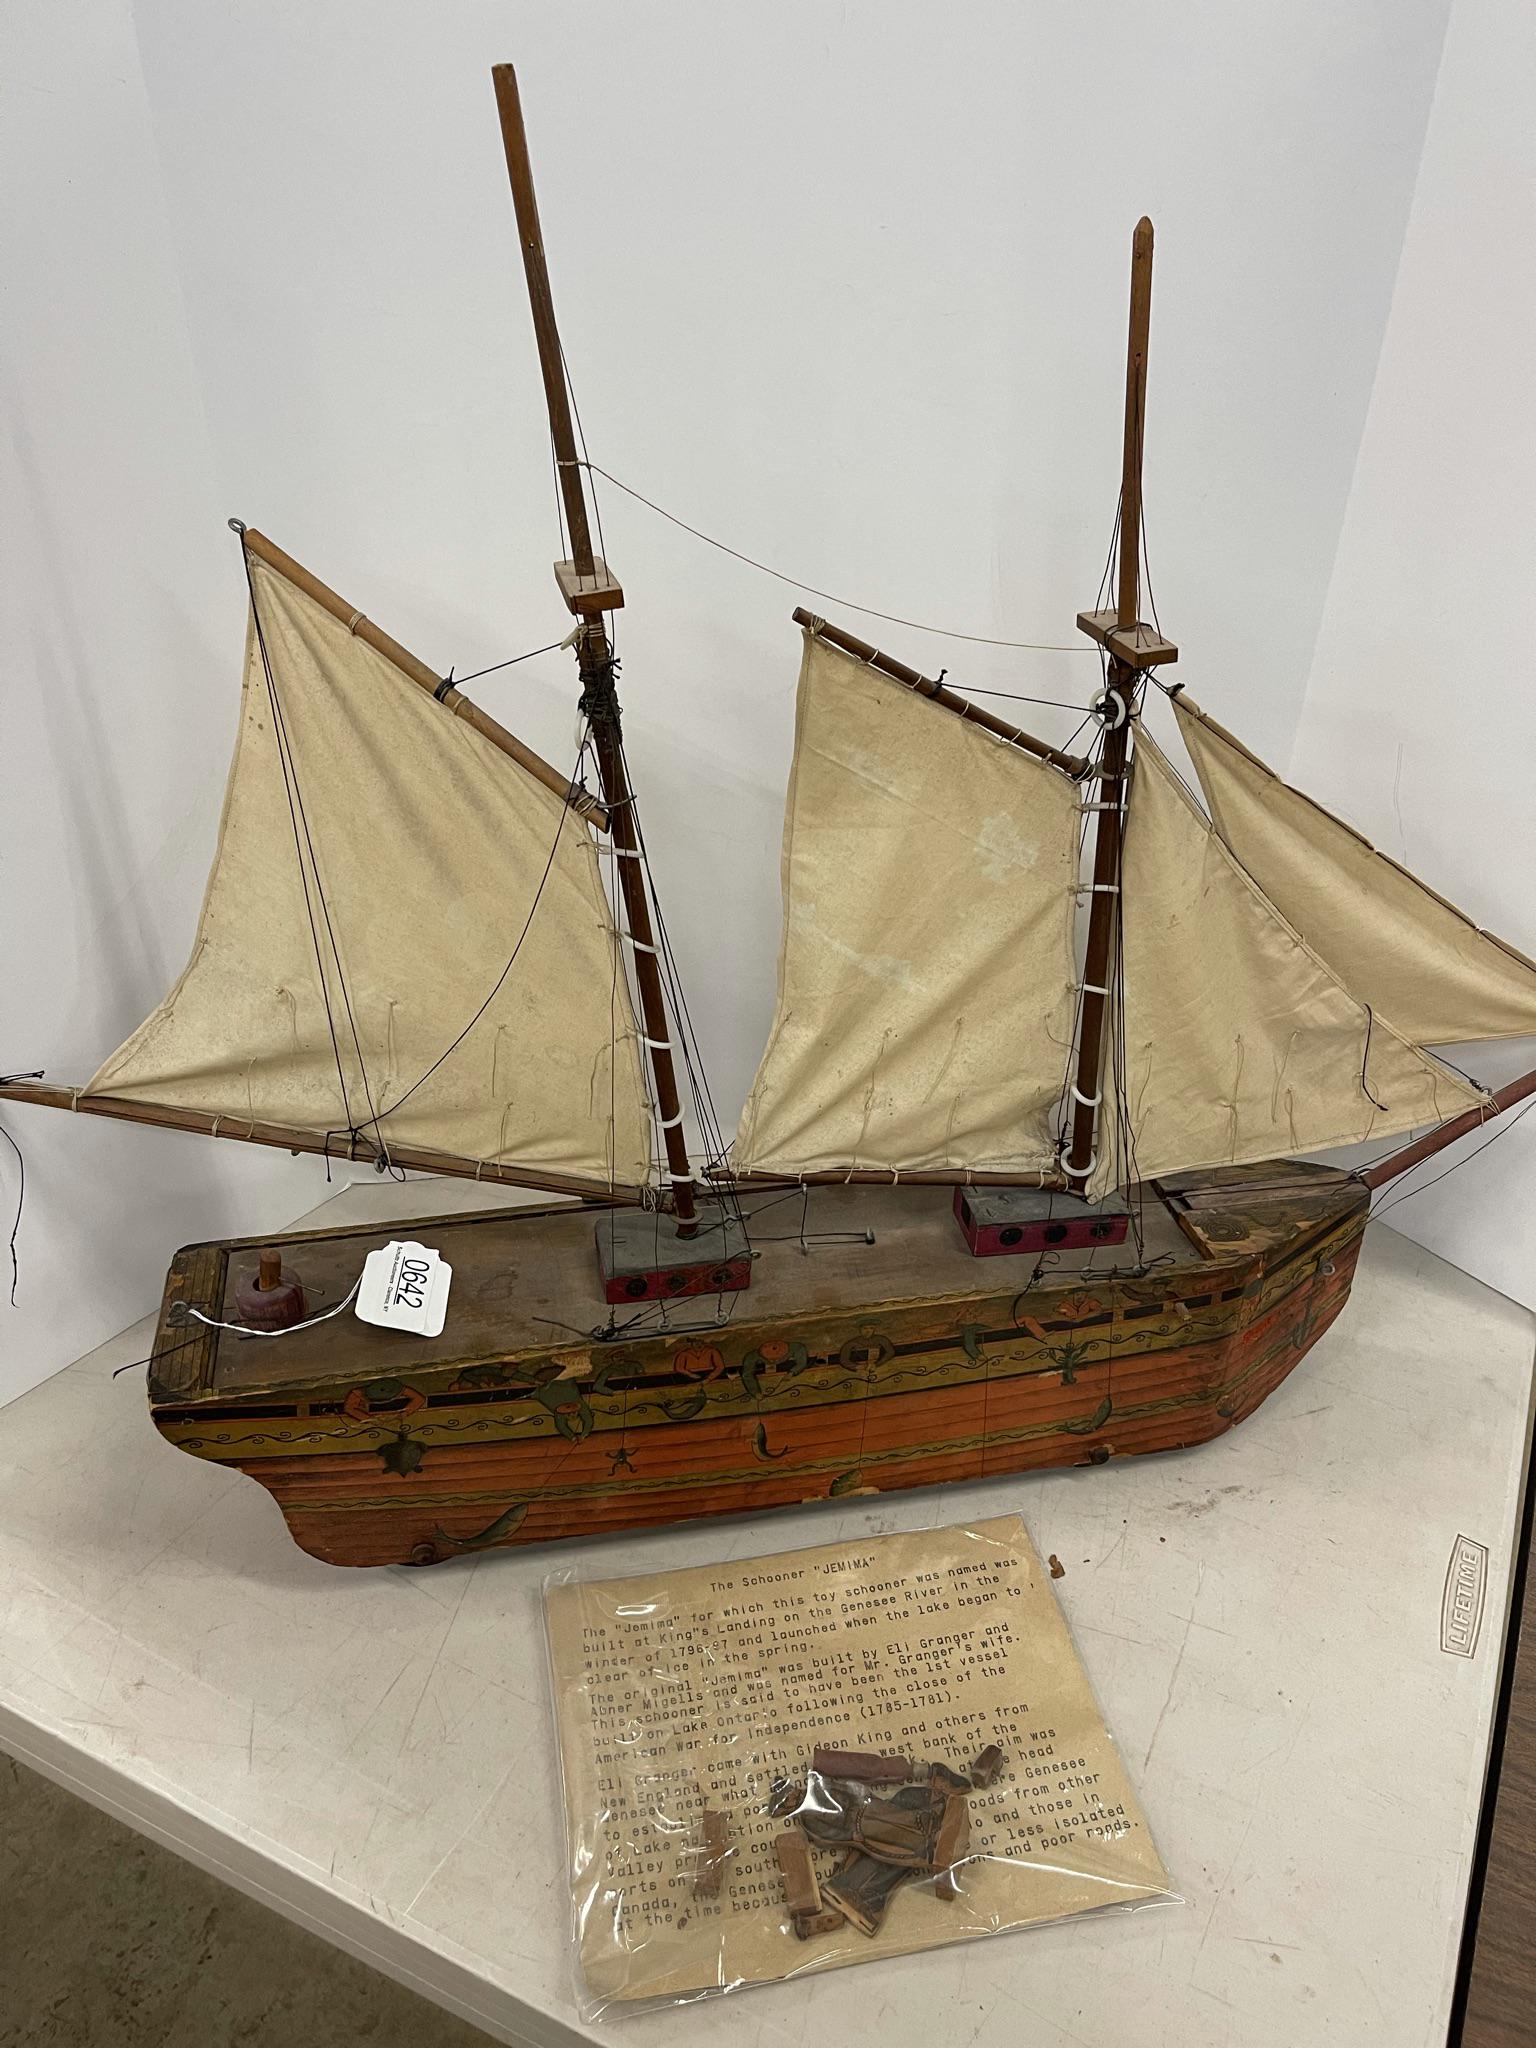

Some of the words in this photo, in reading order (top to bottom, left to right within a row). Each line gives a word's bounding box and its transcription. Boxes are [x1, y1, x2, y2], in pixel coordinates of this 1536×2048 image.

[396, 1259, 430, 1308] 0642
[710, 1582, 733, 1593] The
[742, 1568, 805, 1587] Schooner
[814, 1556, 876, 1574] "JEMIMA"
[583, 1628, 606, 1638] The
[691, 1612, 713, 1622] for
[723, 1602, 764, 1617] which
[773, 1597, 805, 1609] this
[813, 1592, 836, 1603] toy
[845, 1577, 907, 1597] schooner
[916, 1571, 940, 1583] was
[948, 1562, 987, 1577] named
[994, 1558, 1018, 1569] was
[583, 1639, 625, 1653] built
[635, 1636, 650, 1647] at
[717, 1616, 776, 1634] Landing
[784, 1613, 800, 1622] on
[809, 1607, 832, 1618] the
[840, 1596, 897, 1614] Genesee
[904, 1586, 943, 1602] River
[954, 1582, 968, 1592] in
[977, 1575, 1000, 1586] the
[1449, 1551, 1478, 1645] LIFETIME
[645, 1651, 661, 1662] of
[738, 1634, 762, 1647] and
[772, 1622, 837, 1641] launched
[845, 1616, 877, 1629] when
[886, 1610, 910, 1621] the
[918, 1602, 950, 1616] lake
[958, 1592, 998, 1607] began
[1006, 1587, 1021, 1597] to
[587, 1671, 630, 1685] clear
[639, 1667, 654, 1678] of
[666, 1661, 689, 1673] ice
[701, 1658, 715, 1668] in
[724, 1651, 749, 1663] the
[758, 1642, 814, 1659] spring.
[589, 1693, 614, 1705] The
[624, 1680, 692, 1700] original
[702, 1665, 768, 1686] "Jemima"
[778, 1661, 804, 1674] was
[812, 1652, 853, 1668] built
[862, 1649, 877, 1660] by
[887, 1642, 910, 1655] Eli
[920, 1630, 975, 1649] Granger
[985, 1622, 1009, 1636] and
[590, 1702, 632, 1717] Abner
[713, 1685, 738, 1698] and
[747, 1680, 772, 1692] was
[781, 1669, 823, 1686] named
[832, 1664, 855, 1677] for
[864, 1660, 889, 1672] Mr.
[898, 1643, 972, 1665] Granger's
[980, 1634, 1020, 1649] wife.
[592, 1717, 626, 1731] This
[636, 1704, 705, 1724] schooner
[716, 1701, 731, 1711] is
[741, 1692, 774, 1706] said
[784, 1687, 800, 1698] to
[809, 1681, 842, 1694] have
[851, 1673, 884, 1686] been
[893, 1666, 918, 1678] the
[960, 1648, 1009, 1666] vessel
[647, 1729, 664, 1739] on
[673, 1722, 708, 1736] Lake
[717, 1708, 777, 1727] Ontario
[787, 1692, 864, 1714] following
[872, 1687, 897, 1698] the
[907, 1677, 947, 1693] close
[956, 1671, 972, 1682] of
[981, 1666, 1006, 1678] the
[595, 1745, 666, 1765] American
[676, 1738, 701, 1752] War
[713, 1734, 737, 1745] for
[749, 1712, 850, 1739] Independence
[599, 1778, 622, 1791] Eli
[635, 1766, 697, 1787] Granger
[707, 1758, 742, 1773] came
[751, 1750, 787, 1765] with
[796, 1739, 849, 1757] Gideon
[857, 1731, 893, 1745] King
[901, 1722, 927, 1736] and
[935, 1710, 987, 1729] others
[995, 1702, 1029, 1718] from
[944, 1742, 985, 1759] Their
[997, 1735, 1022, 1748] aim
[1030, 1728, 1056, 1742] was
[1018, 1744, 1054, 1761] head
[601, 1796, 626, 1810] New
[637, 1782, 700, 1804] England
[711, 1775, 737, 1790] and
[747, 1761, 808, 1783] settled
[879, 1742, 914, 1758] west
[923, 1733, 957, 1749] bank
[967, 1728, 982, 1740] of
[992, 1723, 1017, 1736] the
[1025, 1757, 1086, 1779] Genesee
[602, 1804, 665, 1822] enesee
[676, 1796, 710, 1811] near
[721, 1785, 757, 1802] what
[970, 1793, 1005, 1810] oods
[1014, 1785, 1050, 1801] from
[1058, 1772, 1101, 1791] other
[993, 1808, 1020, 1824] and
[1028, 1798, 1073, 1816] those
[1083, 1792, 1100, 1805] in
[603, 1829, 620, 1842] to
[605, 1846, 621, 1861] of
[633, 1841, 671, 1857] Lake
[784, 1817, 800, 1828] on
[981, 1833, 997, 1846] or
[1007, 1823, 1044, 1840] less
[1054, 1804, 1125, 1830] isolated
[1005, 1841, 1032, 1857] and
[1041, 1831, 1076, 1850] poor
[1086, 1819, 1139, 1838] roads.
[608, 1860, 663, 1877] Valley
[668, 1877, 686, 1888] on
[735, 1857, 781, 1876] south
[612, 1897, 677, 1917] Canada,
[729, 1878, 785, 1898] Genese
[617, 1919, 633, 1932] at
[644, 1913, 673, 1927] the
[684, 1906, 721, 1920] time
[732, 1893, 788, 1912] becaus
